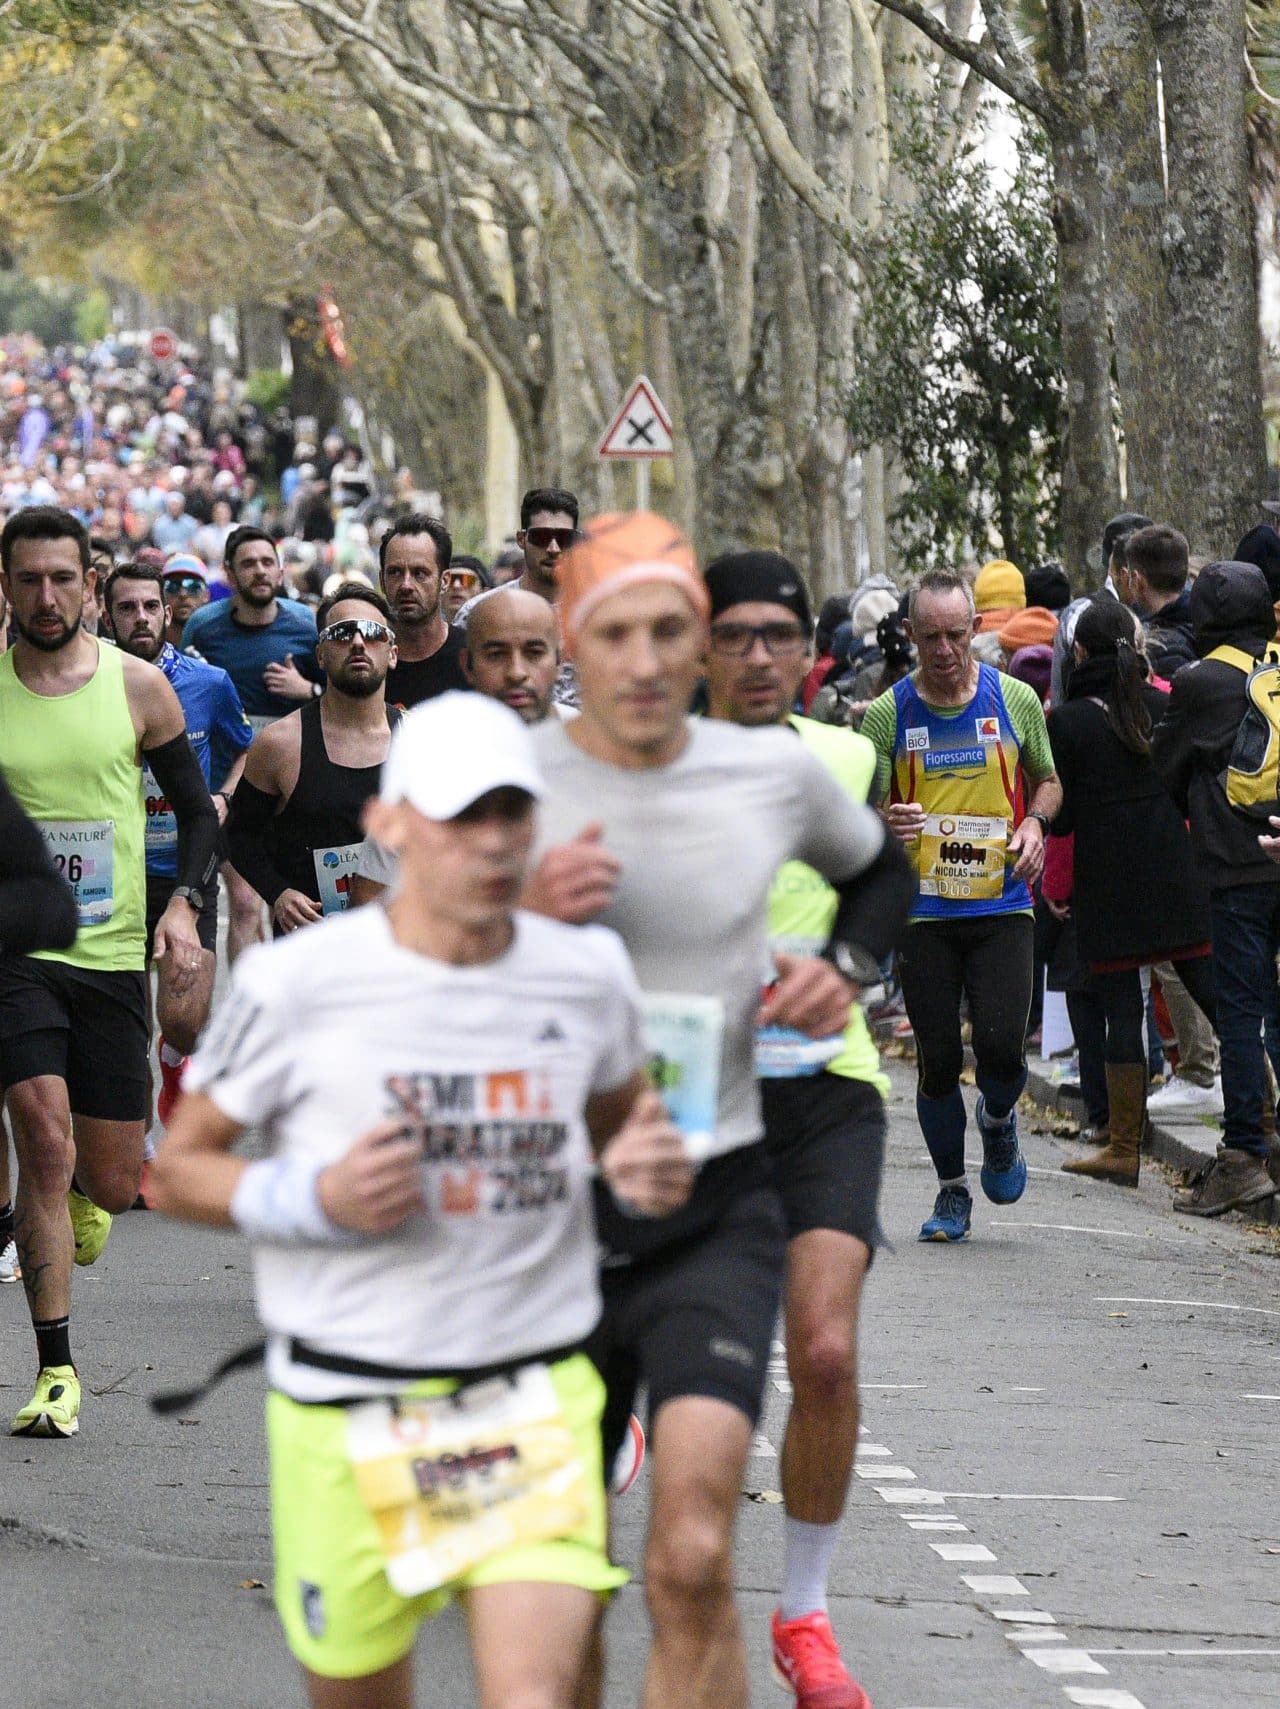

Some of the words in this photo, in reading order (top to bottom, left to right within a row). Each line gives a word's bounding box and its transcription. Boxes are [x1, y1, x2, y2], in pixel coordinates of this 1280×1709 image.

[925, 750, 983, 766] Floressance
[58, 830, 107, 843] NATURE
[935, 865, 968, 878] NICOLAS
[938, 880, 971, 897] Duo
